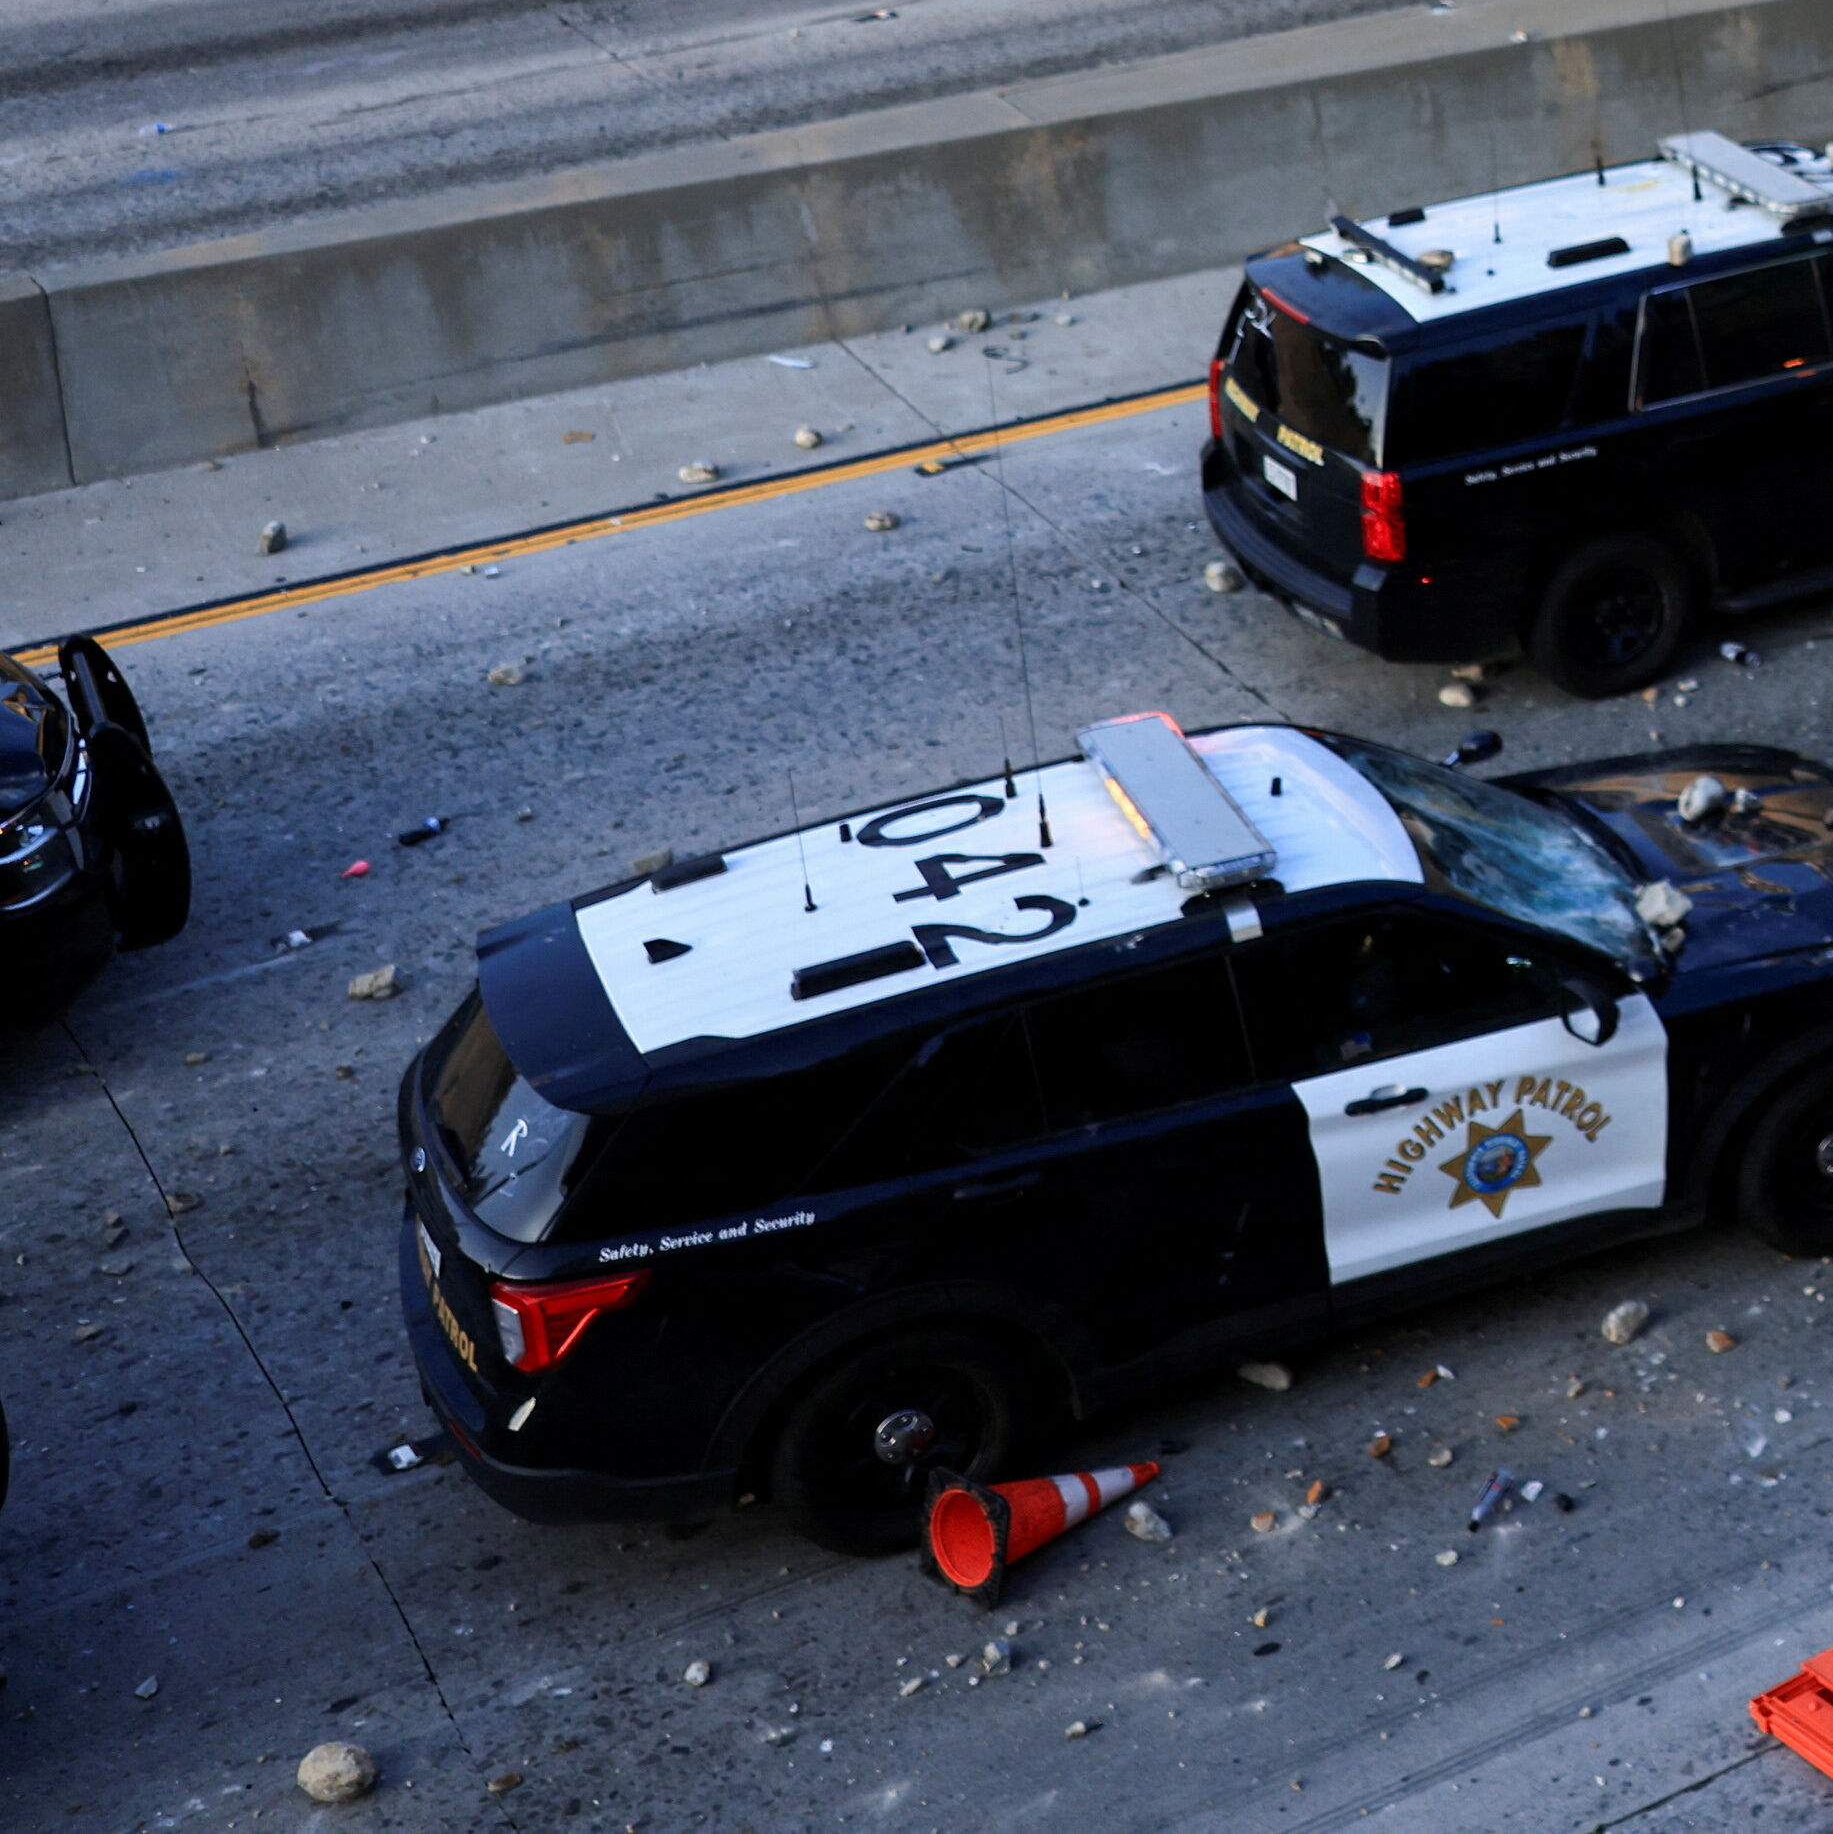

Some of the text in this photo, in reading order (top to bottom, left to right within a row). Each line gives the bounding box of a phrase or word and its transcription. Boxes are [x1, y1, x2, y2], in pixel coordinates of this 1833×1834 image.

[856, 794, 1077, 971] 042
[1372, 1079, 1506, 1195] HIGHWAY
[1514, 1075, 1612, 1144] PATROL
[599, 1210, 815, 1263] Safety, Service and Security
